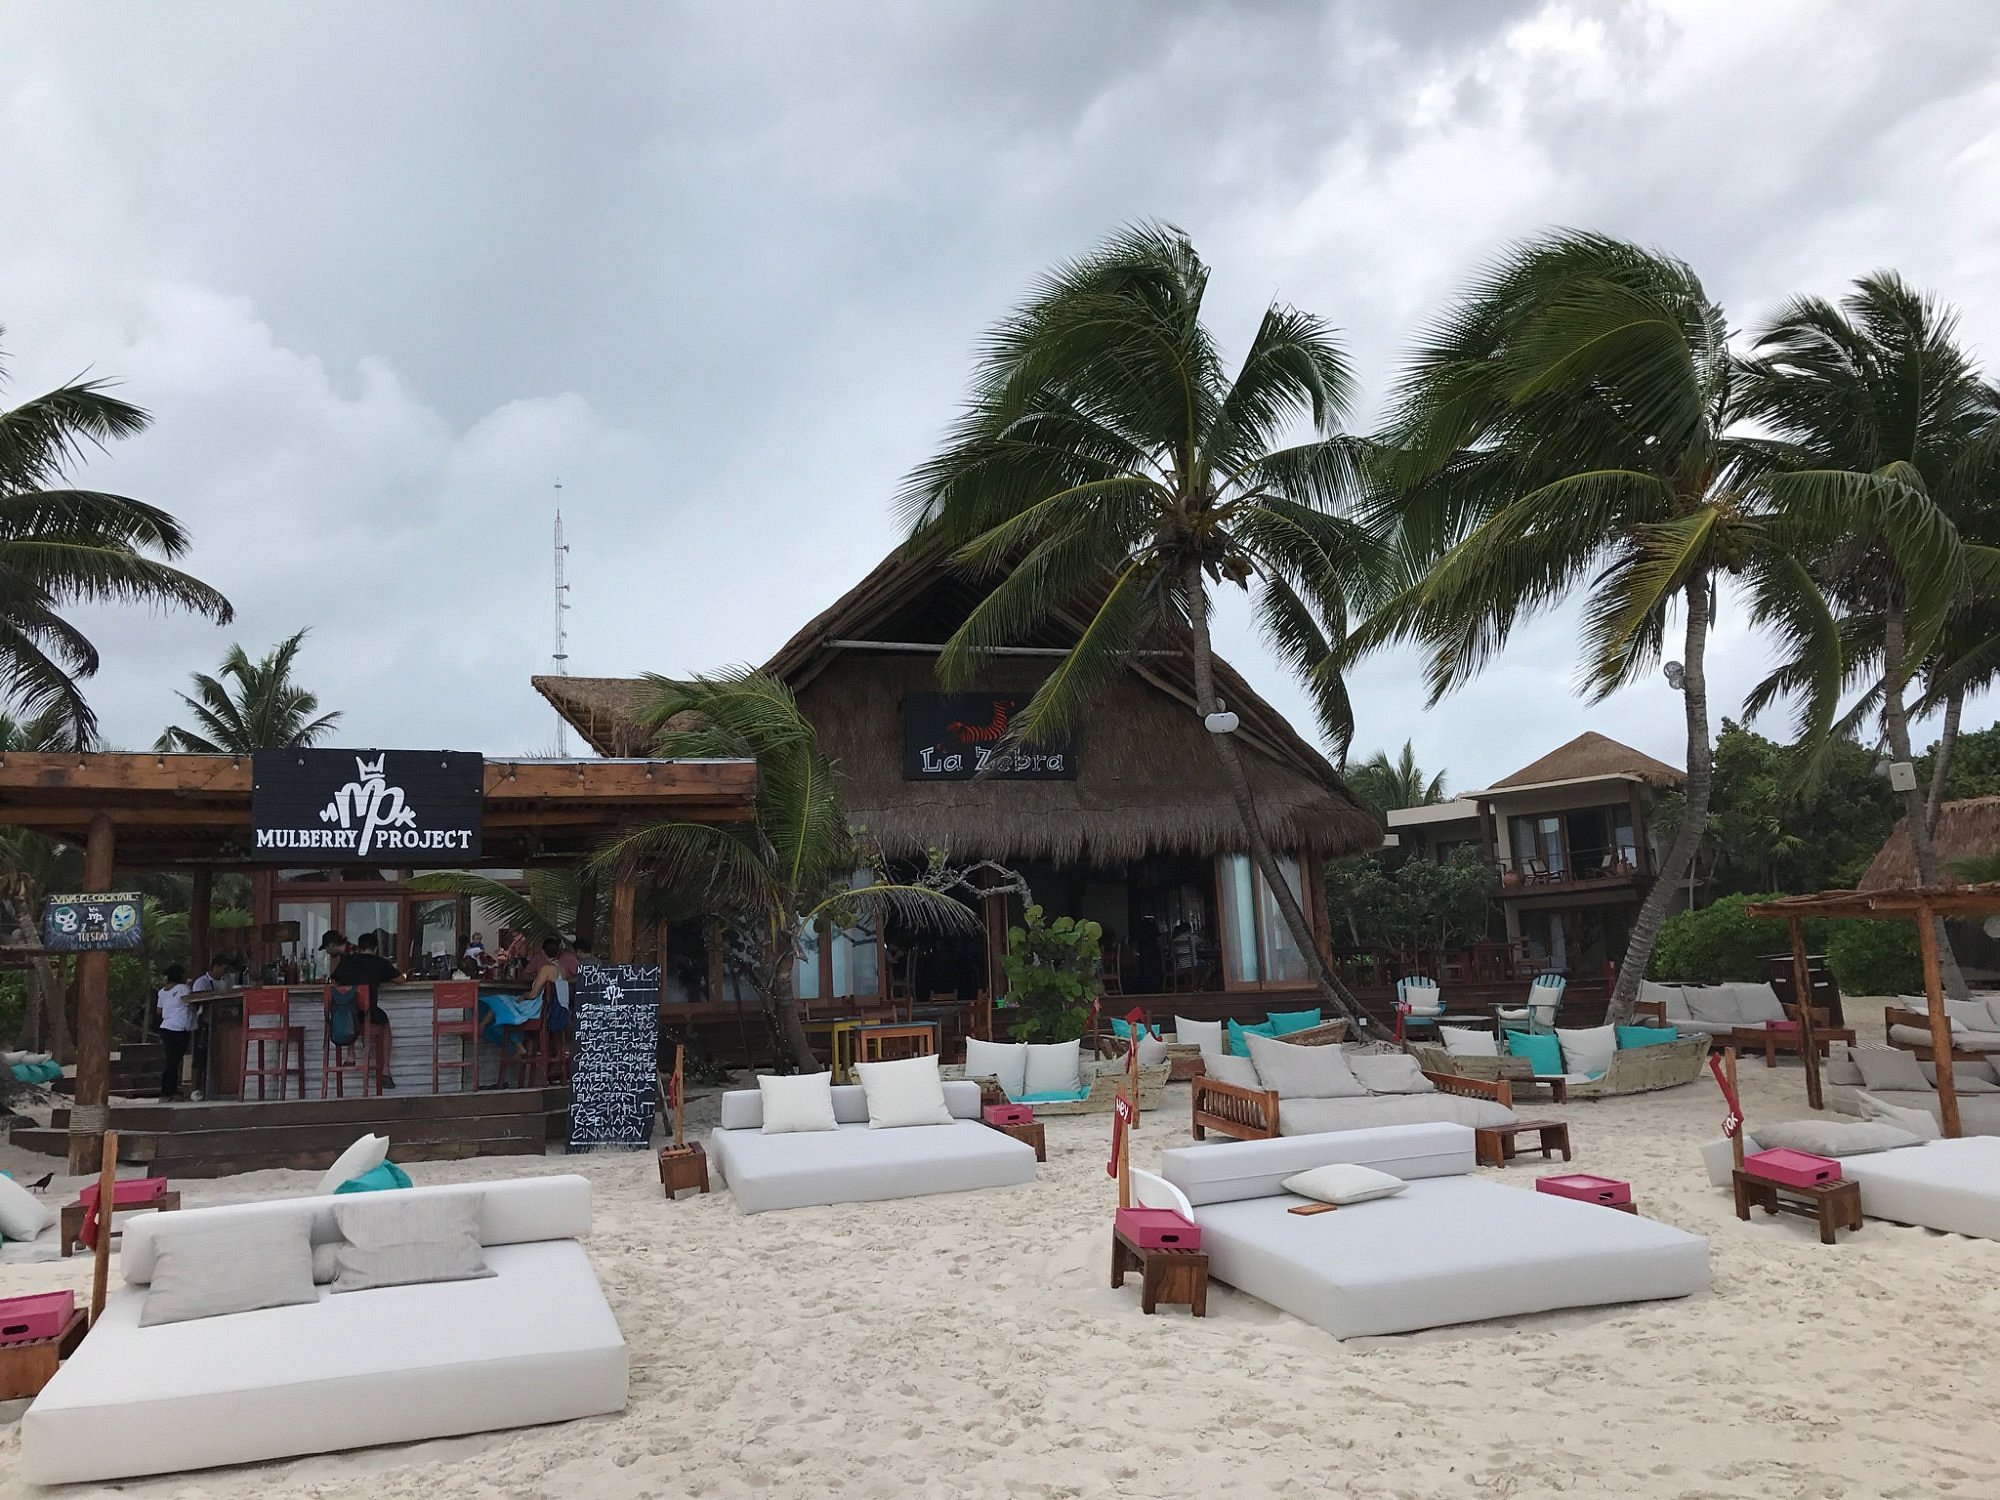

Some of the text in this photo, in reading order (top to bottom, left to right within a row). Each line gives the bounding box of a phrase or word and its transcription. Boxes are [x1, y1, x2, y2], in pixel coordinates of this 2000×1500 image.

[920, 746, 963, 772] La
[256, 829, 472, 848] MULBERRY PROJECT
[577, 964, 600, 974] NEW
